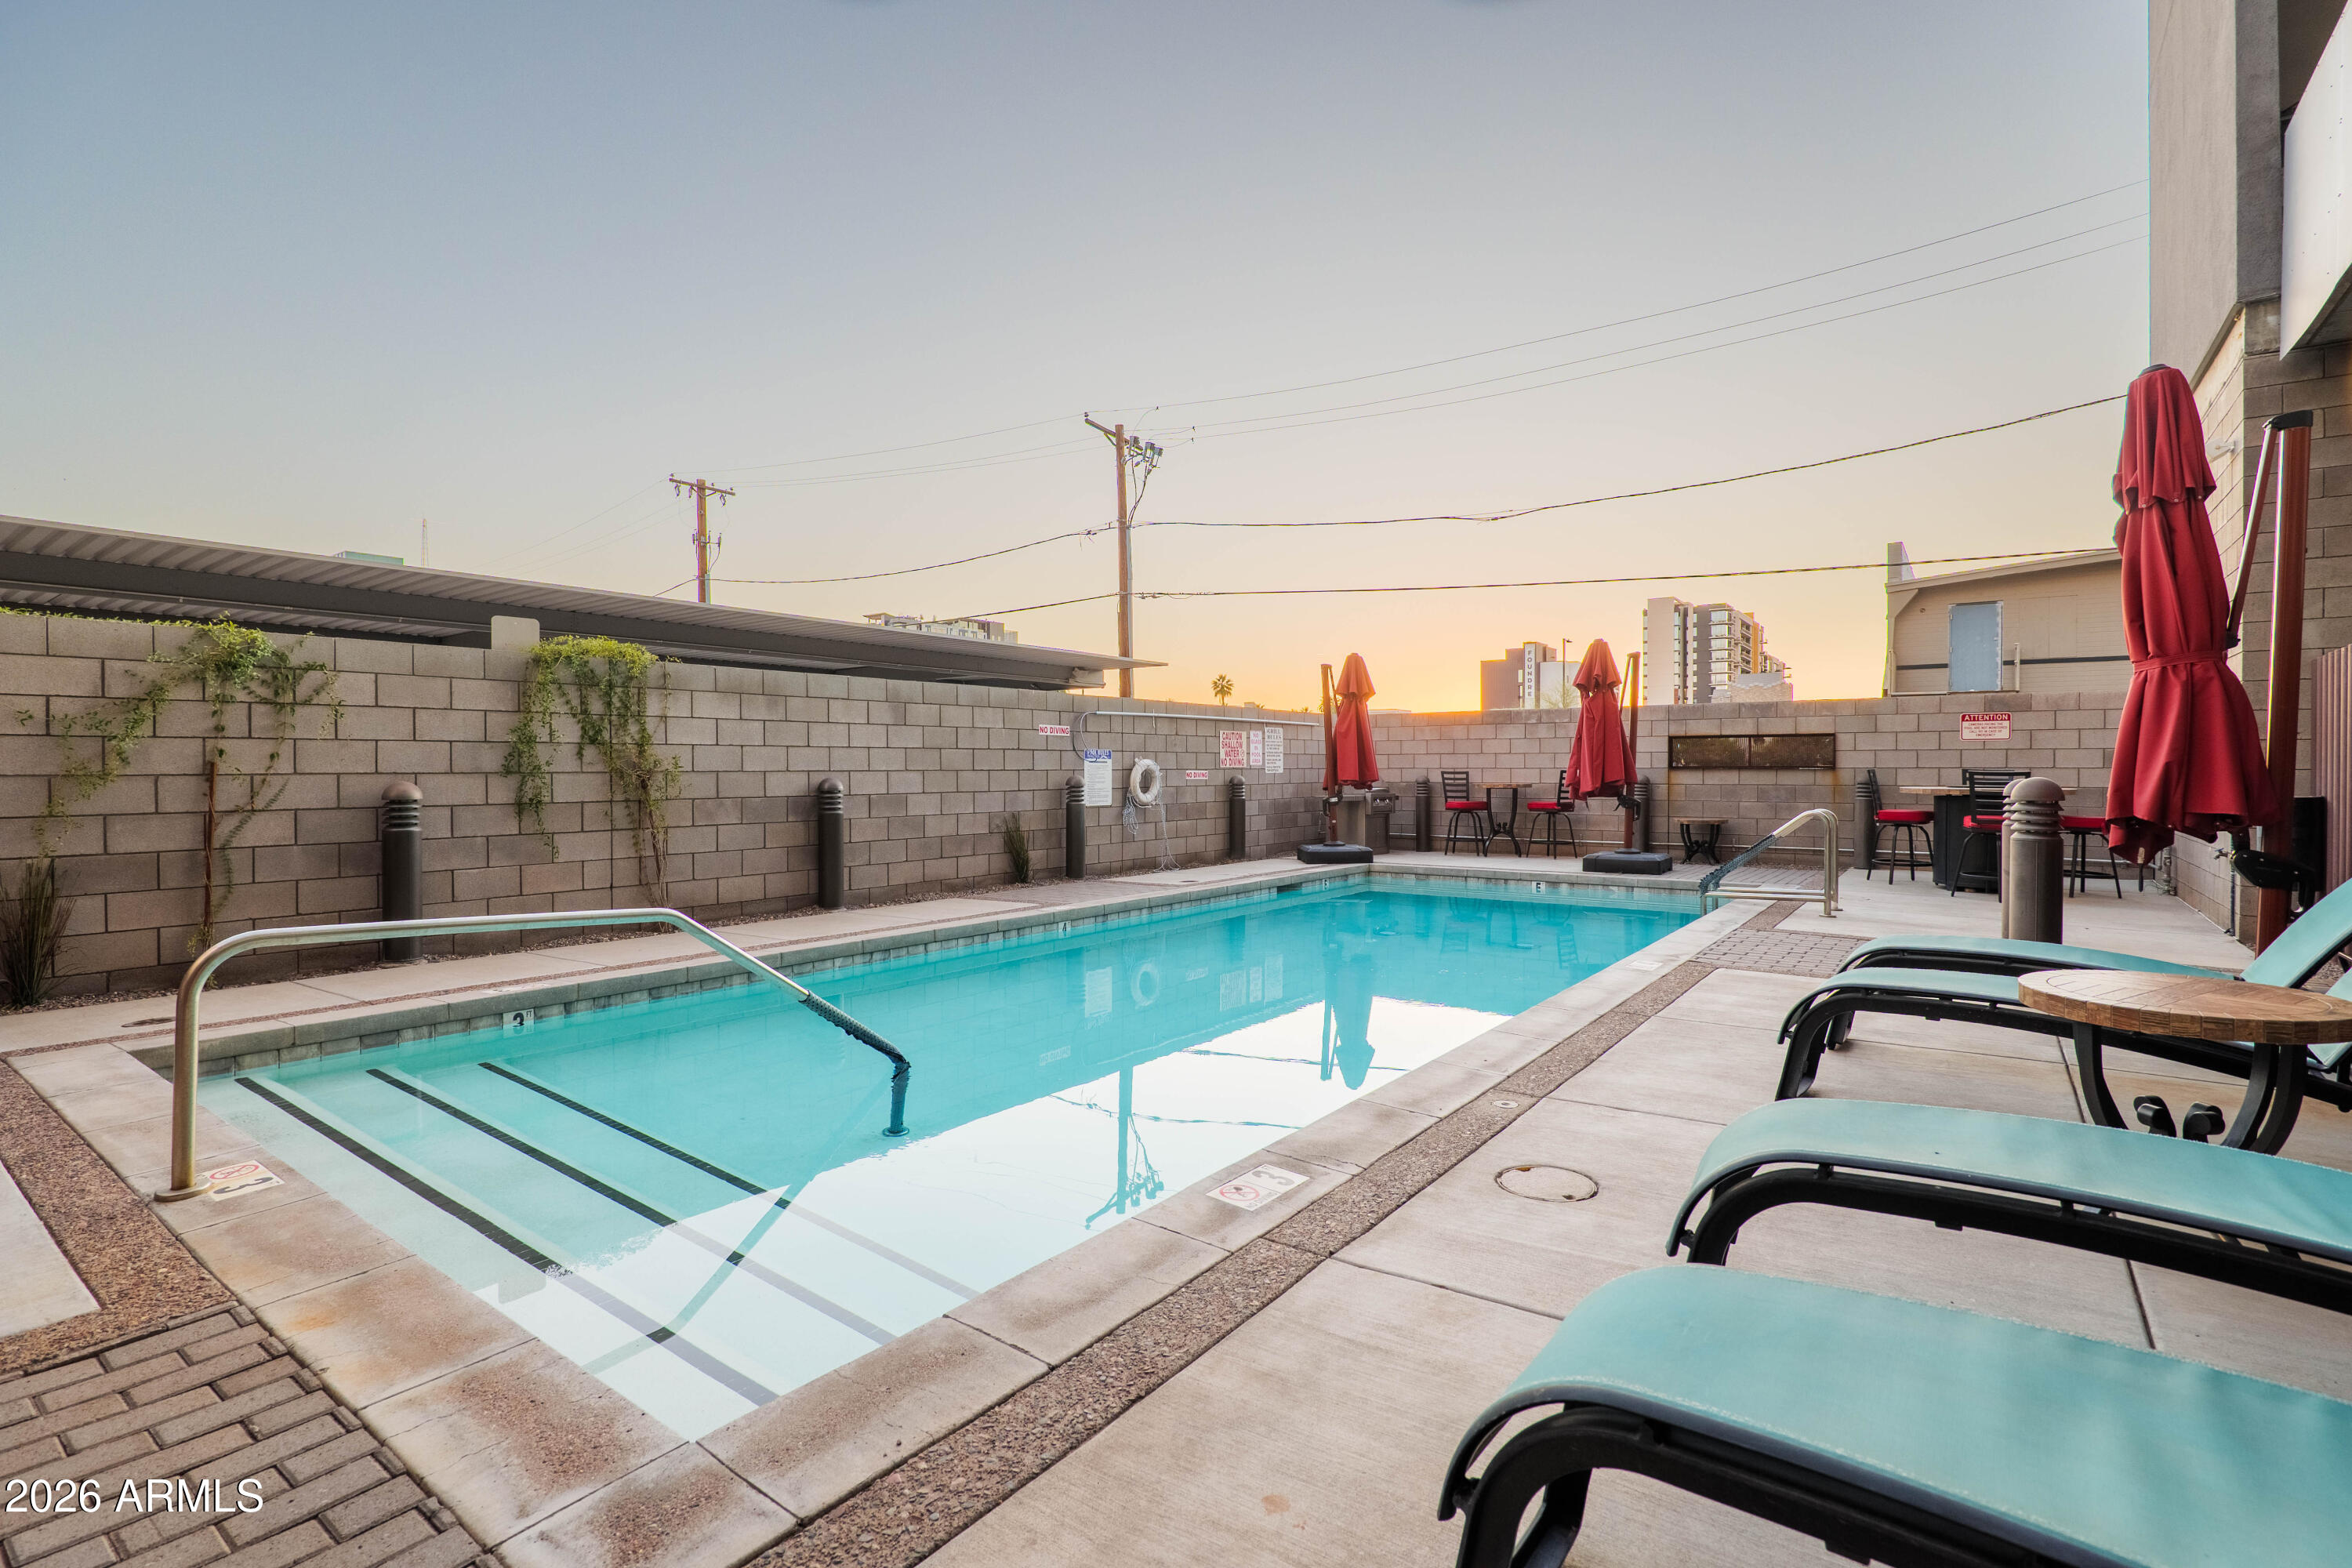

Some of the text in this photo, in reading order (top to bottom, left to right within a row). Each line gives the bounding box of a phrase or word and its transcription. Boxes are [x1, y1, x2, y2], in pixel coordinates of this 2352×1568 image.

[1222, 732, 1242, 740] CAUTION
[1221, 740, 1243, 750] SHALLOW
[1225, 749, 1240, 758] WATER
[1221, 757, 1244, 767] NO DIVING
[1251, 1170, 1295, 1186] 3
[212, 1177, 274, 1194] 3
